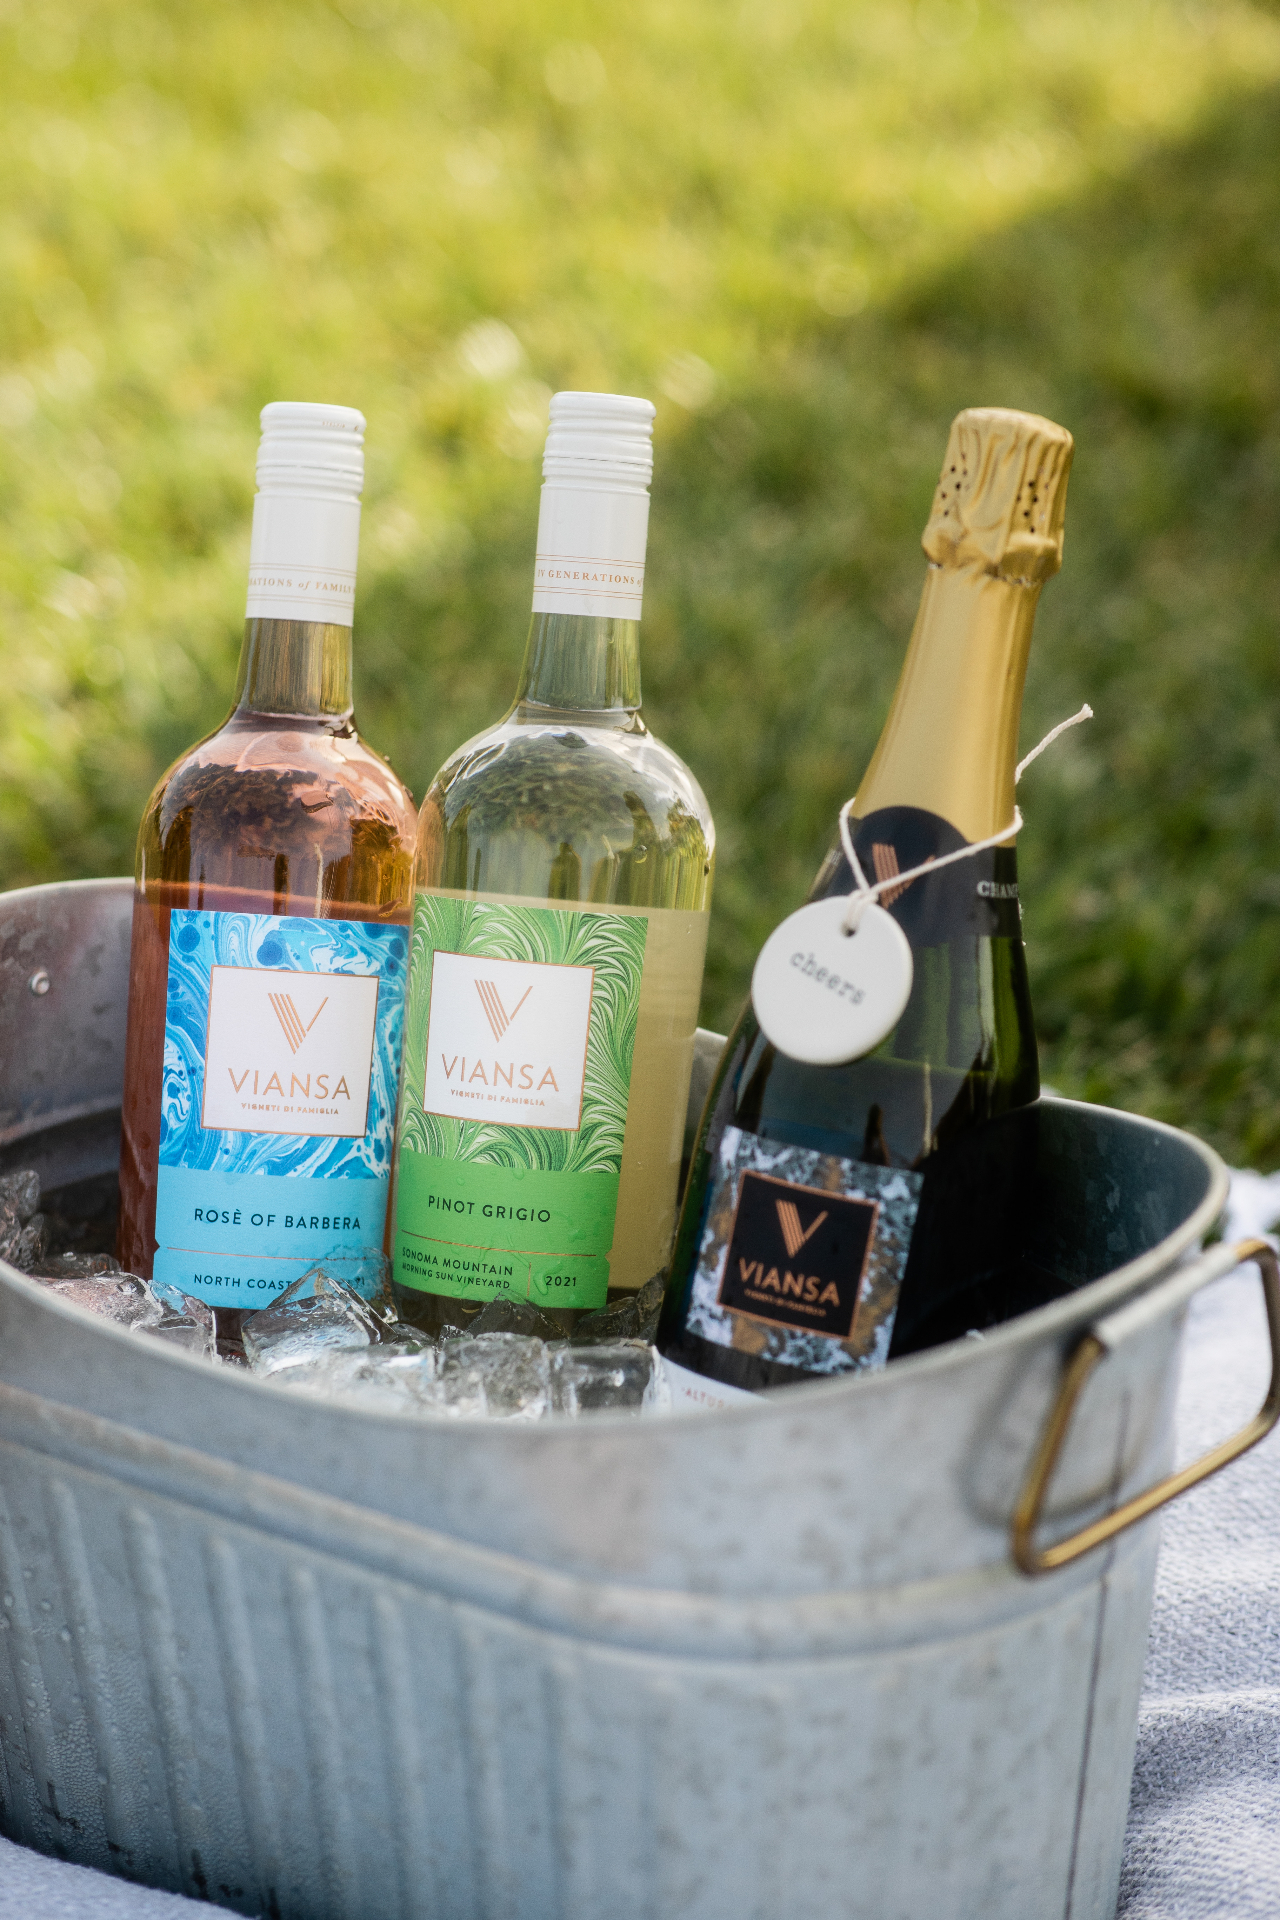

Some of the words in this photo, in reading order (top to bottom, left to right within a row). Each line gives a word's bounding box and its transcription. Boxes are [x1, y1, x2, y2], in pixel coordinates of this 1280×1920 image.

[298, 580, 311, 591] of
[548, 570, 635, 585] GENERATIONS
[789, 950, 866, 1007] cheers
[227, 1067, 351, 1101] VIANSA
[441, 1053, 560, 1093] VIANSA
[241, 1102, 281, 1113] VIGNETI
[283, 1105, 295, 1114] DI
[297, 1106, 340, 1116] FAMIGLIA
[450, 1088, 485, 1101] VIGNETI
[487, 1095, 499, 1103] DI
[500, 1095, 546, 1107] FAMIGLIA
[428, 1195, 476, 1215] PINOT
[482, 1204, 551, 1223] GRIGIO
[250, 1213, 277, 1228] OF
[284, 1215, 362, 1231] BARBERA
[401, 1246, 440, 1267] SONOMA
[442, 1257, 514, 1277] MOUNTAIN
[193, 1273, 242, 1289] NORTH
[246, 1278, 293, 1291] COAST
[401, 1262, 434, 1279] MORNING
[435, 1272, 455, 1282] SUN
[456, 1274, 511, 1290] VINEYARD
[545, 1275, 578, 1288] 2021
[738, 1256, 841, 1308] VIANSA
